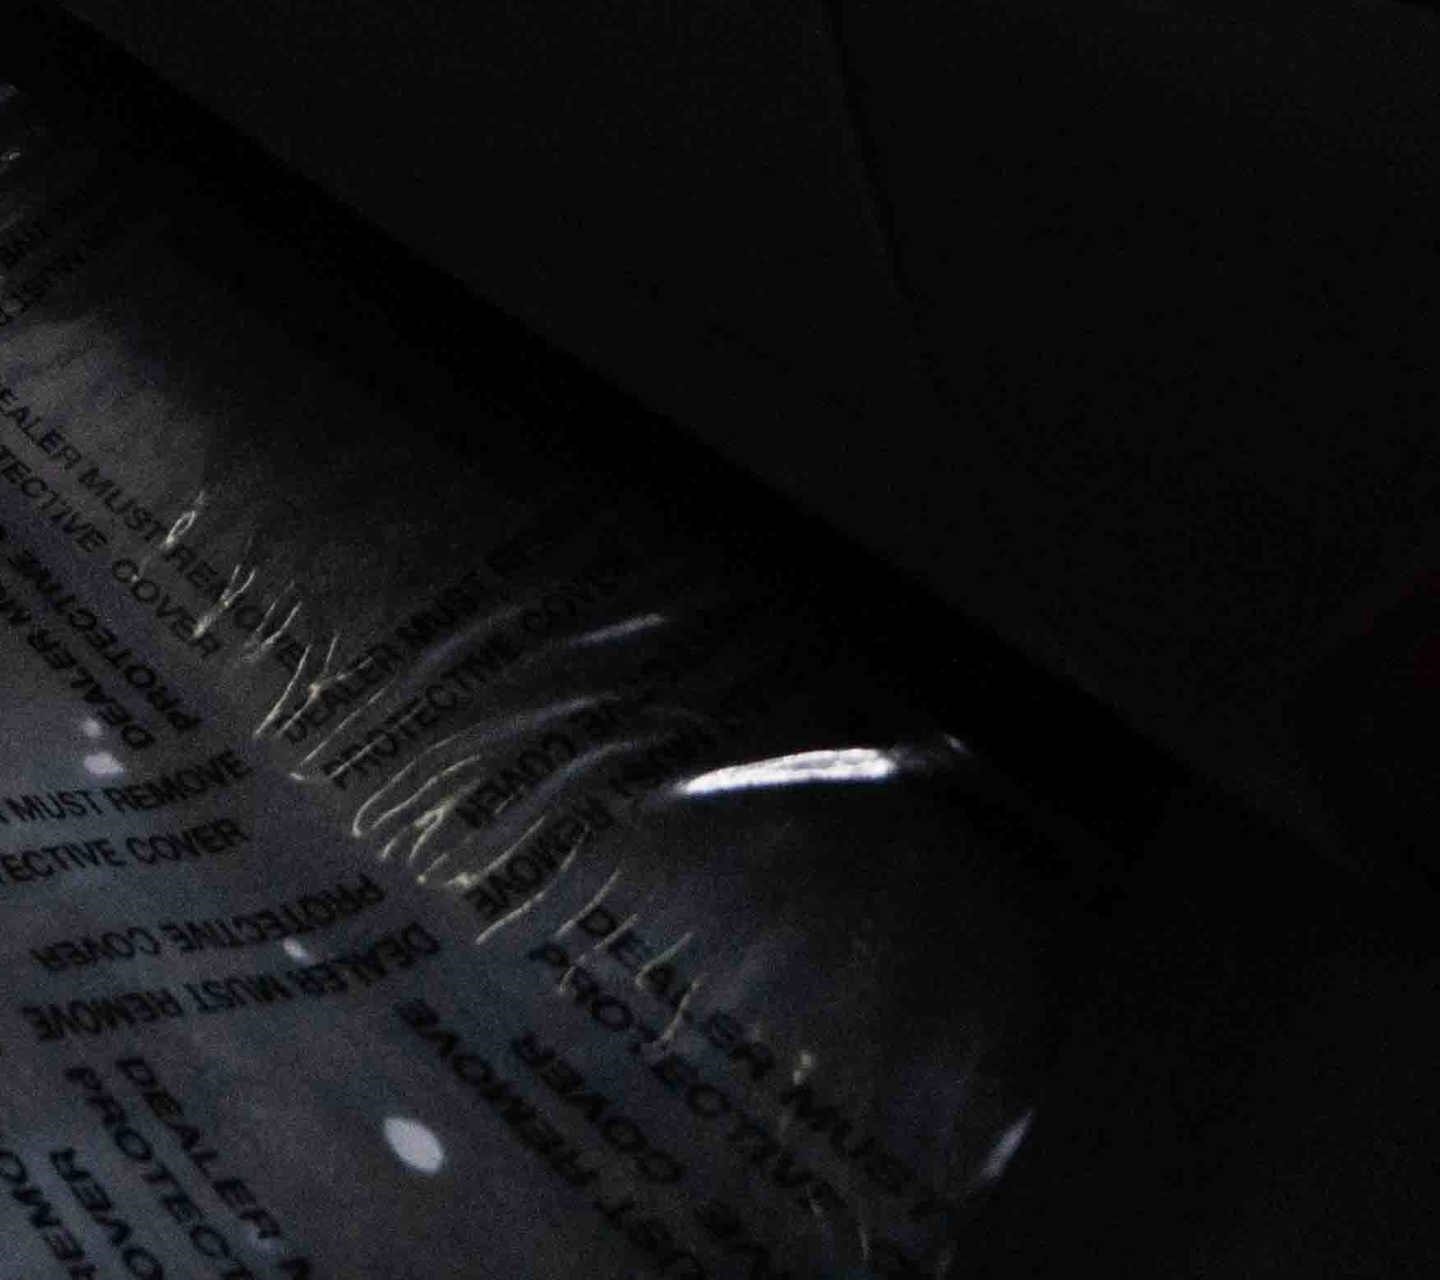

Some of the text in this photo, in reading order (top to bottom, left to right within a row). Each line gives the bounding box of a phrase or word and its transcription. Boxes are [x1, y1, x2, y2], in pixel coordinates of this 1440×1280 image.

[77, 466, 170, 547] MUST
[5, 545, 204, 732] PROTECTIVE
[110, 556, 224, 662] COVER
[25, 626, 157, 751] DEALER
[3, 786, 107, 825] MUST
[102, 748, 255, 814] REMOVE
[125, 816, 251, 865] COVER
[29, 873, 389, 974] PROTECTIVE COVER
[21, 986, 187, 1042] REMOVE
[183, 968, 294, 1017] MUST
[114, 1057, 286, 1240] DEALER
